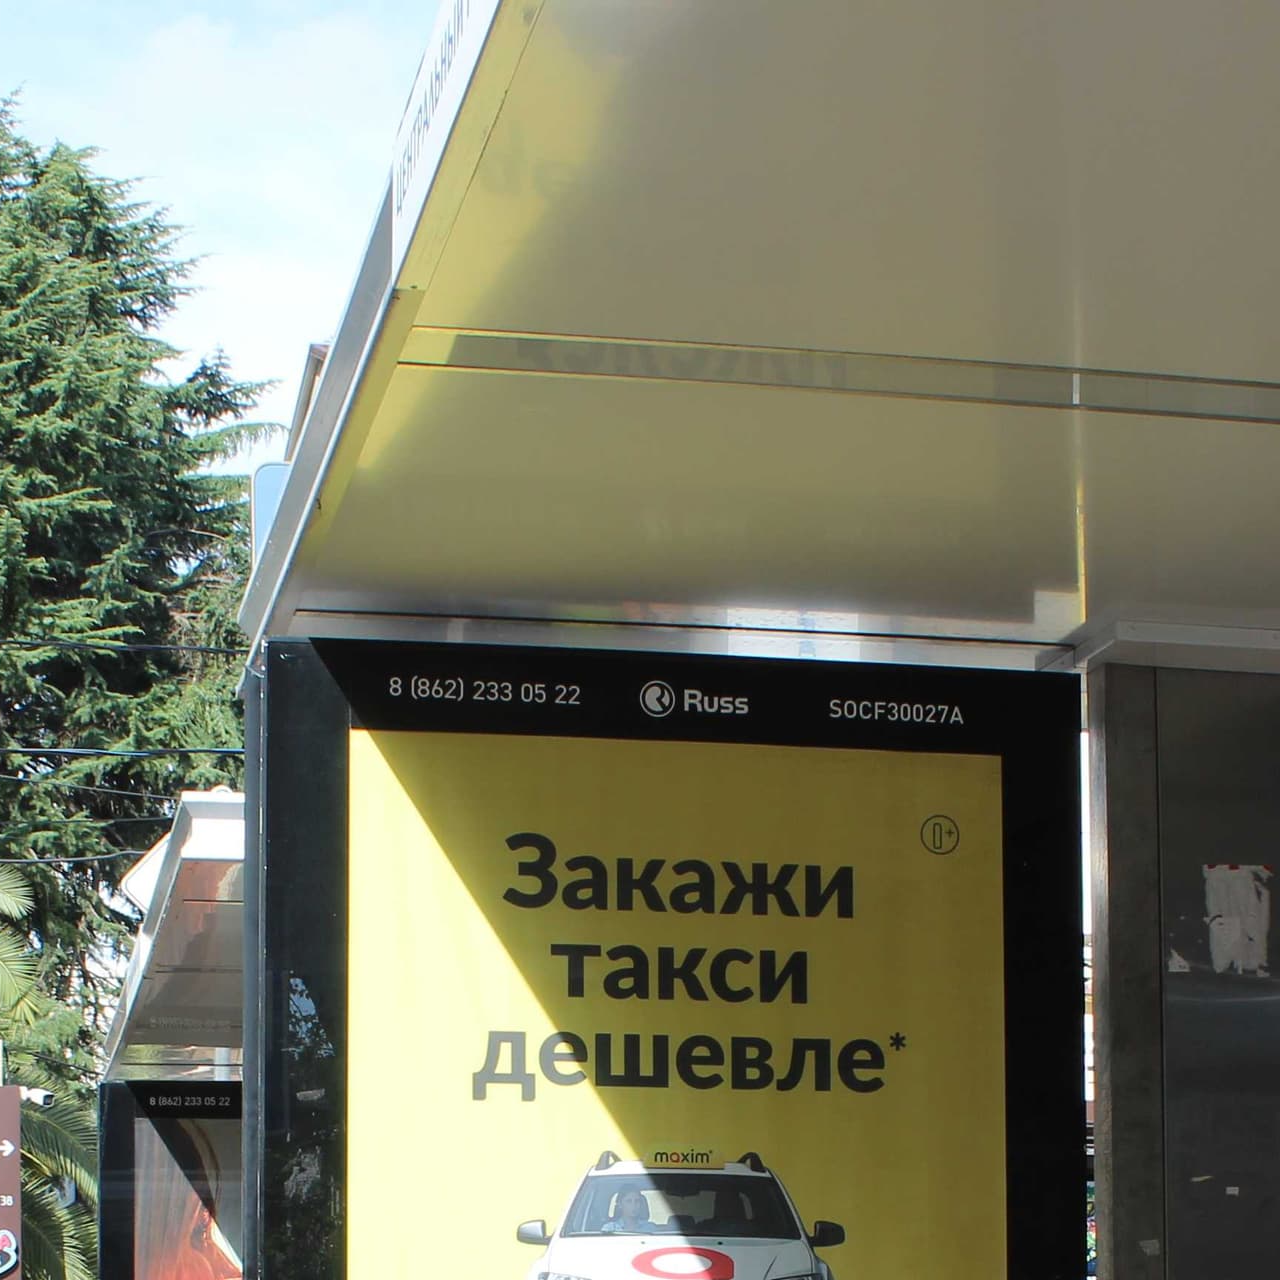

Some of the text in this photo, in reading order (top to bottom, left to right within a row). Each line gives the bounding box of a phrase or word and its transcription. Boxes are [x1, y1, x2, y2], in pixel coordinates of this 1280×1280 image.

[389, 676, 581, 706] 8 (862) 233 05 22
[683, 688, 749, 715] Russ
[829, 699, 964, 726] SOCF30027A
[502, 832, 855, 919] Закажи
[550, 943, 809, 1005] такси
[219, 1097, 231, 1106] 22
[0, 1195, 13, 1207] 38
